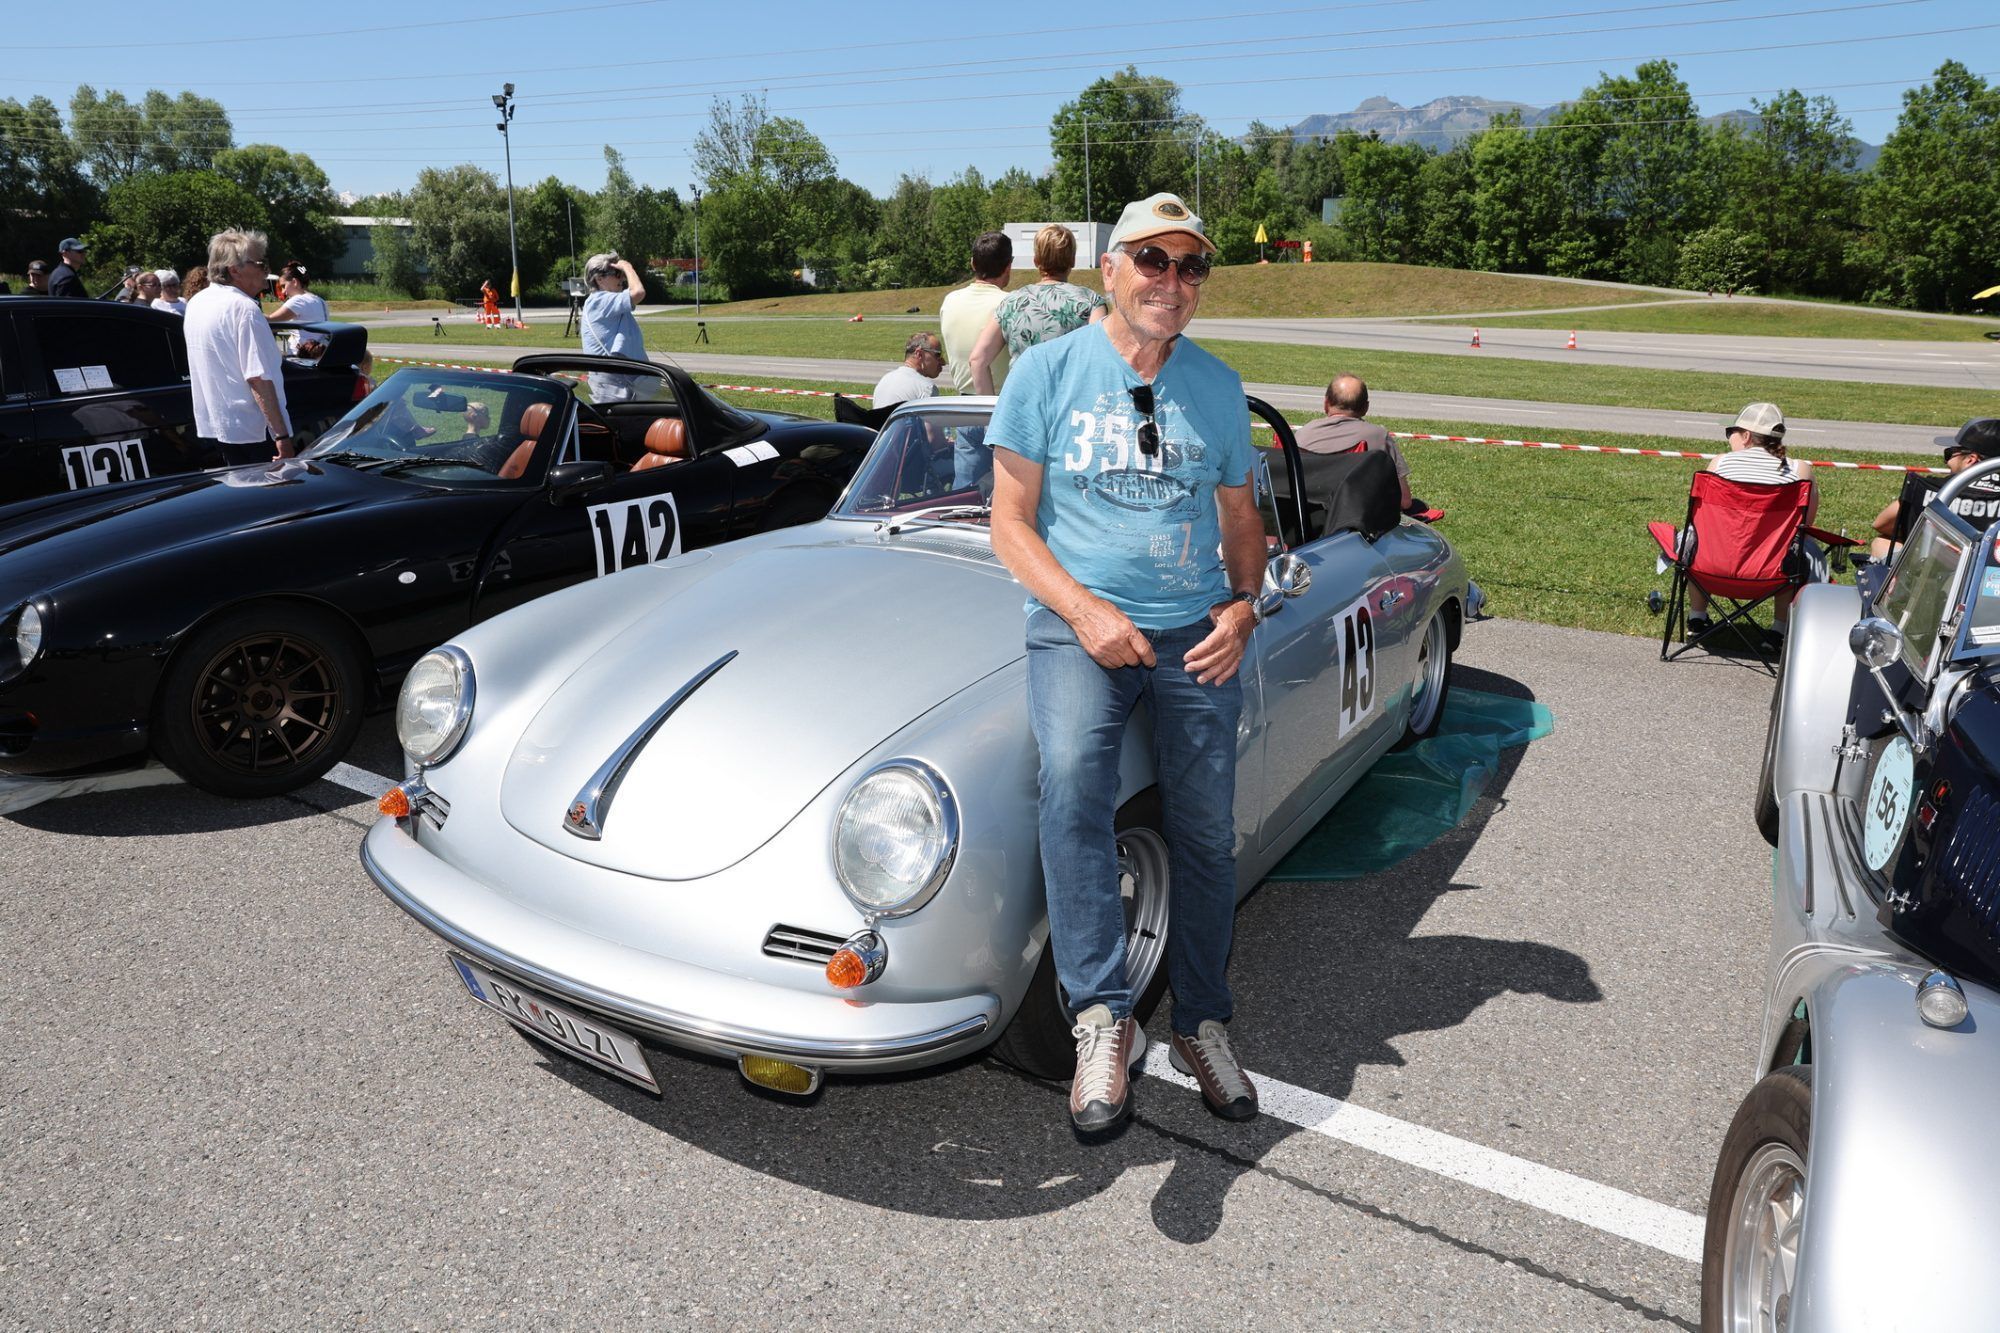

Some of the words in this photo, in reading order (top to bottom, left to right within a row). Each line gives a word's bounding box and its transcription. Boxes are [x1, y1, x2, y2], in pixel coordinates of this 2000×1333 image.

[595, 500, 676, 577] 142
[1342, 606, 1375, 725] 43
[1876, 775, 1899, 831] 156
[490, 979, 534, 1021] FK
